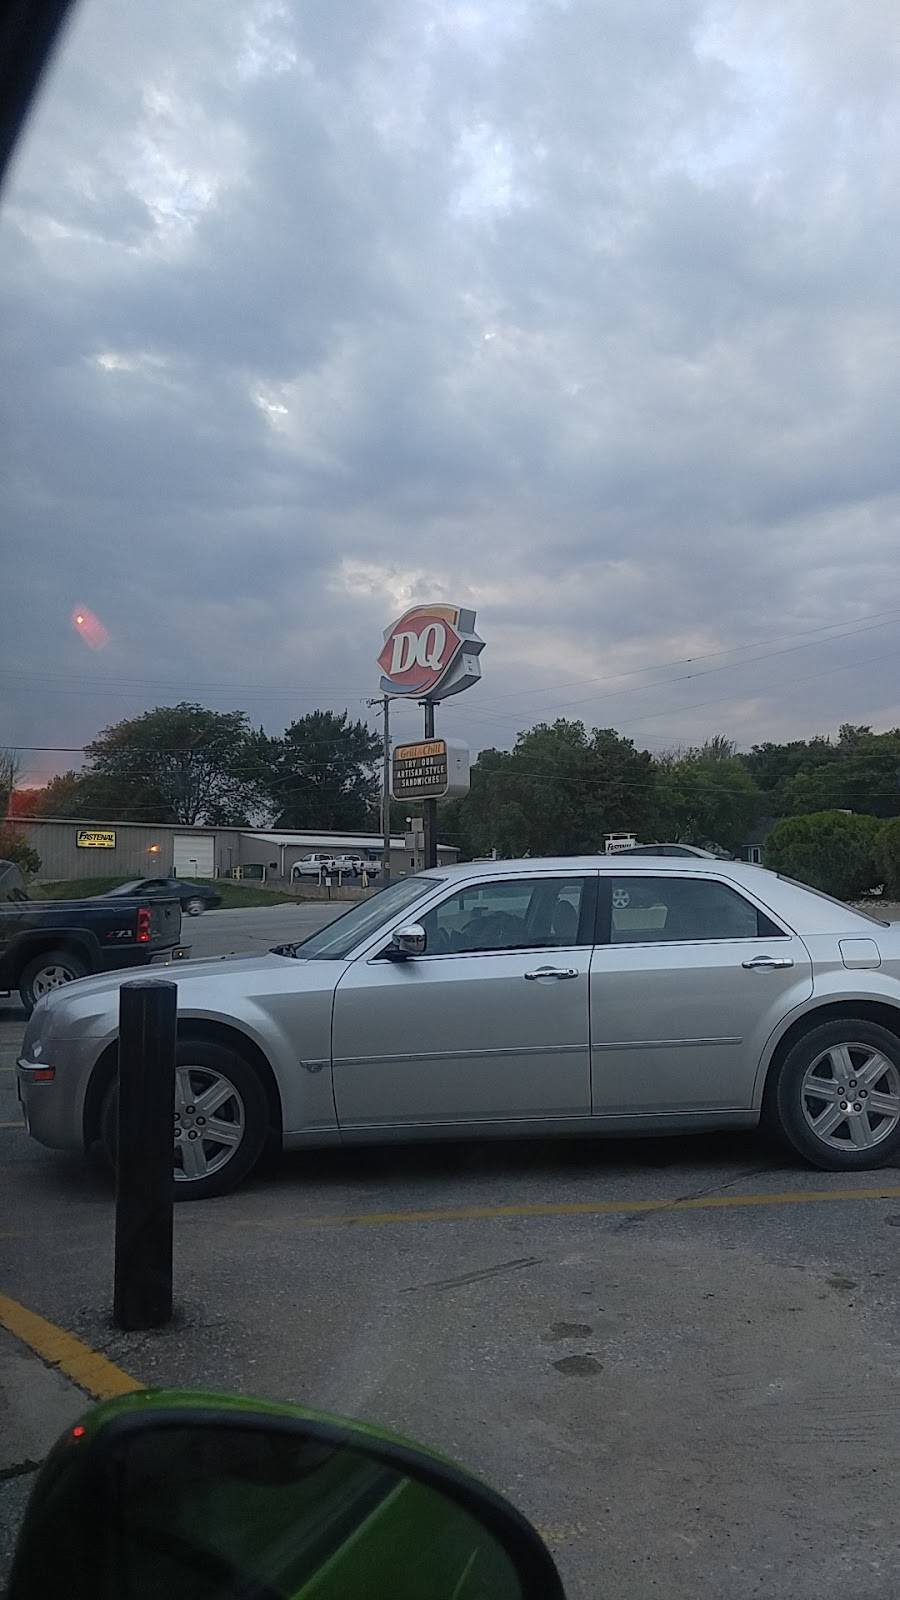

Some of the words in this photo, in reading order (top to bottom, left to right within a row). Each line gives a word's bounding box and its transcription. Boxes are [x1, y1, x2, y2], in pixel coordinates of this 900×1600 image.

[390, 623, 446, 674] DQ
[404, 760, 417, 768] TRY
[421, 757, 434, 766] OUR
[397, 768, 423, 778] ARTISAN
[425, 765, 444, 775] STYLE
[401, 775, 440, 787] SANDWICHES
